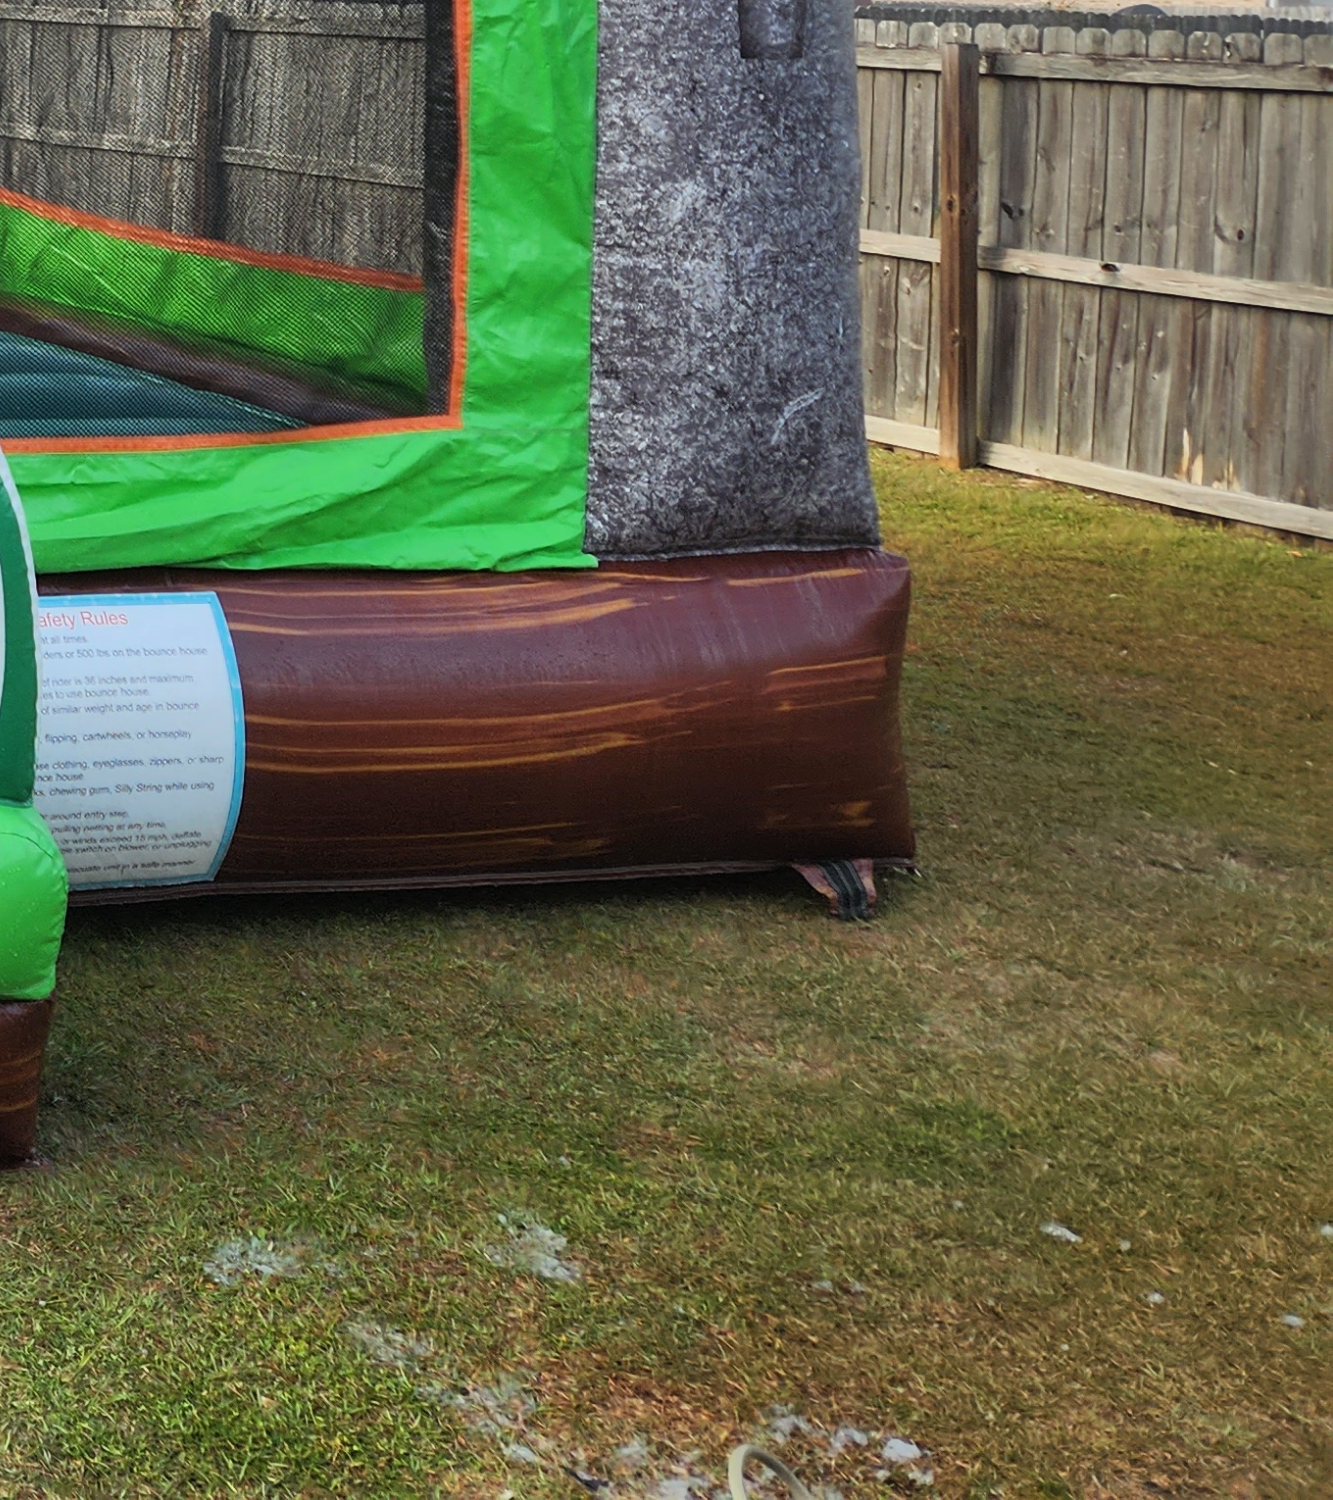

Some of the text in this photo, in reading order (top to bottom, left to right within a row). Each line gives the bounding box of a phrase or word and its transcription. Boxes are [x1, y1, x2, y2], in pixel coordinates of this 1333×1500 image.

[39, 611, 128, 629] afety Rules
[77, 649, 94, 658] 500
[126, 649, 141, 657] the
[144, 648, 180, 656] bounce
[84, 703, 113, 716] weight
[117, 703, 133, 712] and
[136, 704, 153, 714] age
[167, 702, 200, 710] bounce
[136, 783, 162, 793] String
